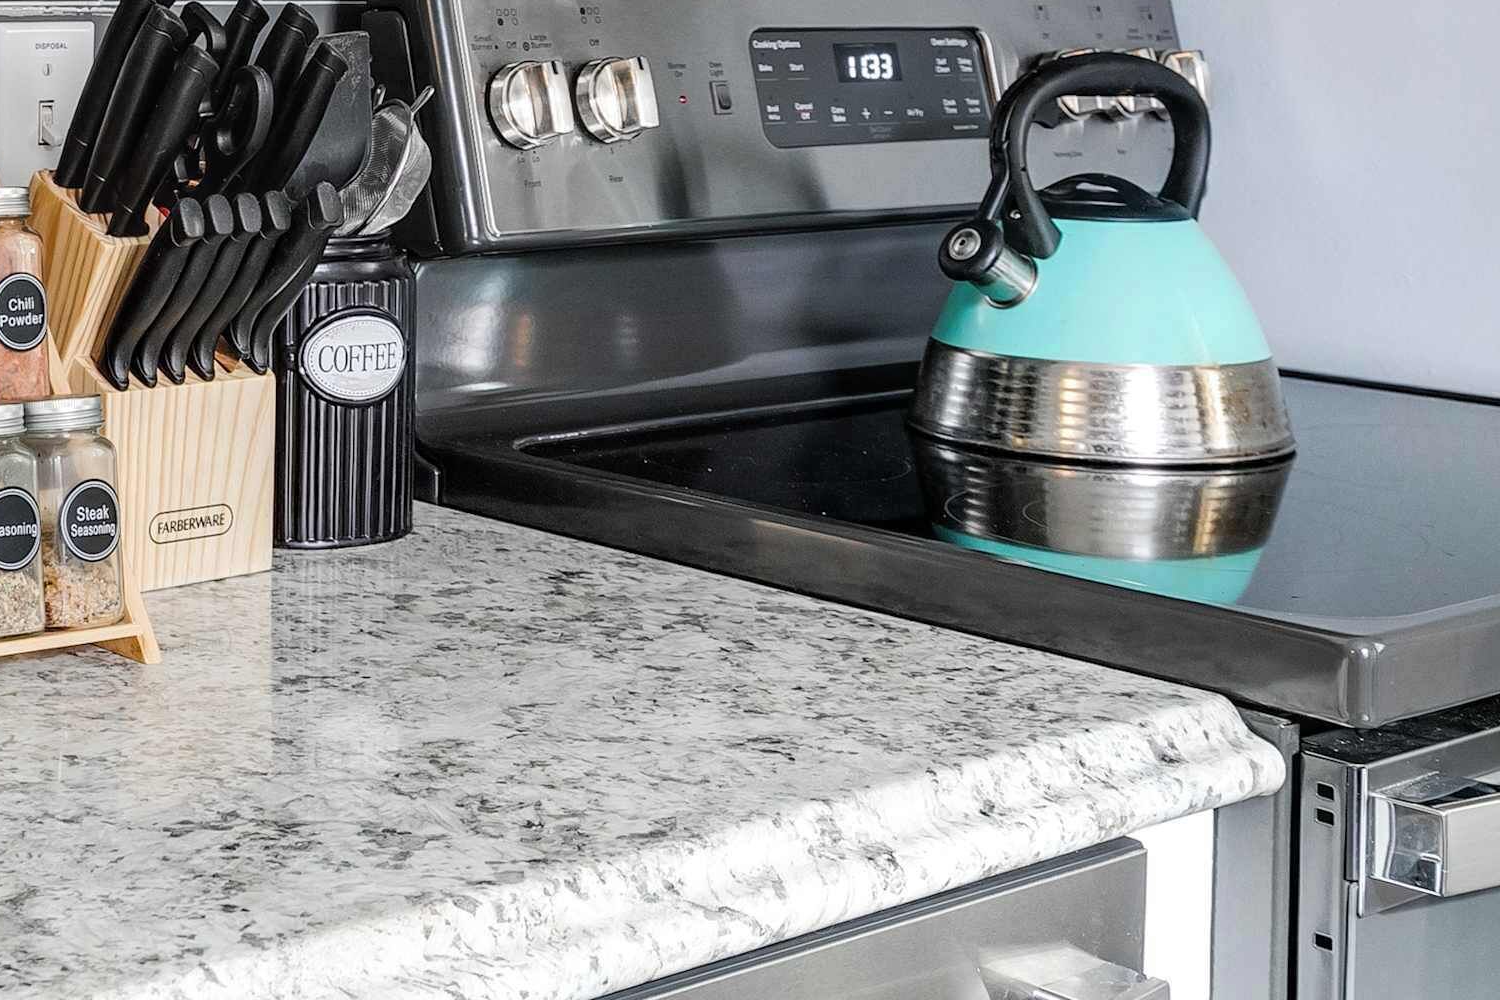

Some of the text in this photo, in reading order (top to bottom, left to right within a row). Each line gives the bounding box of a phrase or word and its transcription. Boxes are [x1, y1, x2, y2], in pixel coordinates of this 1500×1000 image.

[35, 42, 68, 50] DISPOSAL
[8, 297, 35, 312] Chili
[0, 312, 44, 328] Powder
[318, 341, 397, 373] COFFEE
[76, 504, 110, 522] Steak
[70, 522, 116, 538] Seasoning
[157, 513, 226, 536] FARBERWARE
